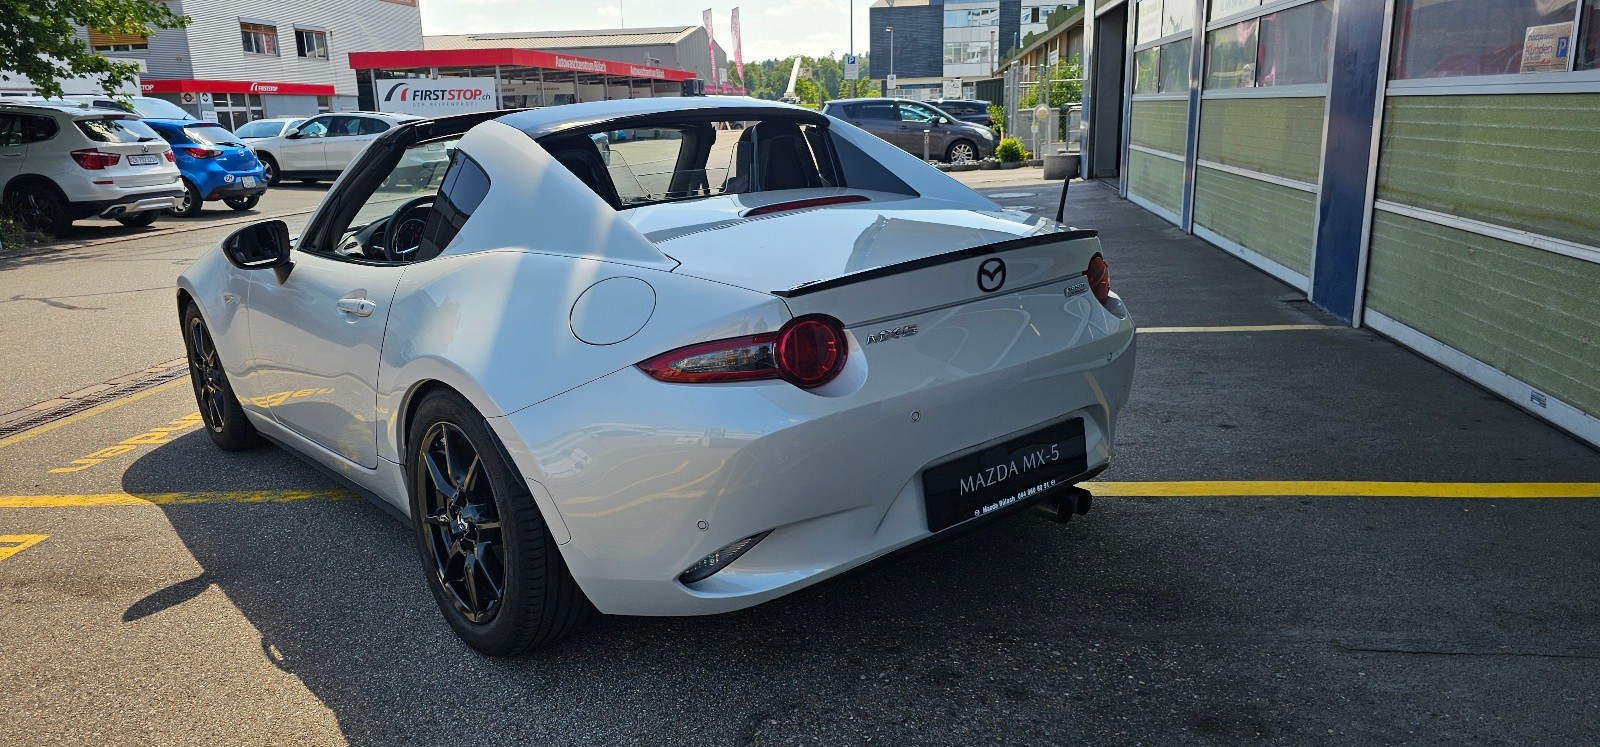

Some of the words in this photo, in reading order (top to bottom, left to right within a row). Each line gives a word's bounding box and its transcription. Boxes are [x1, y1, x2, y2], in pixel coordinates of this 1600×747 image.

[412, 89, 491, 102] FIRSTSTOP.ch
[865, 324, 918, 345] MX-5
[959, 460, 1019, 496] MAZDA
[1022, 443, 1060, 472] MX-5
